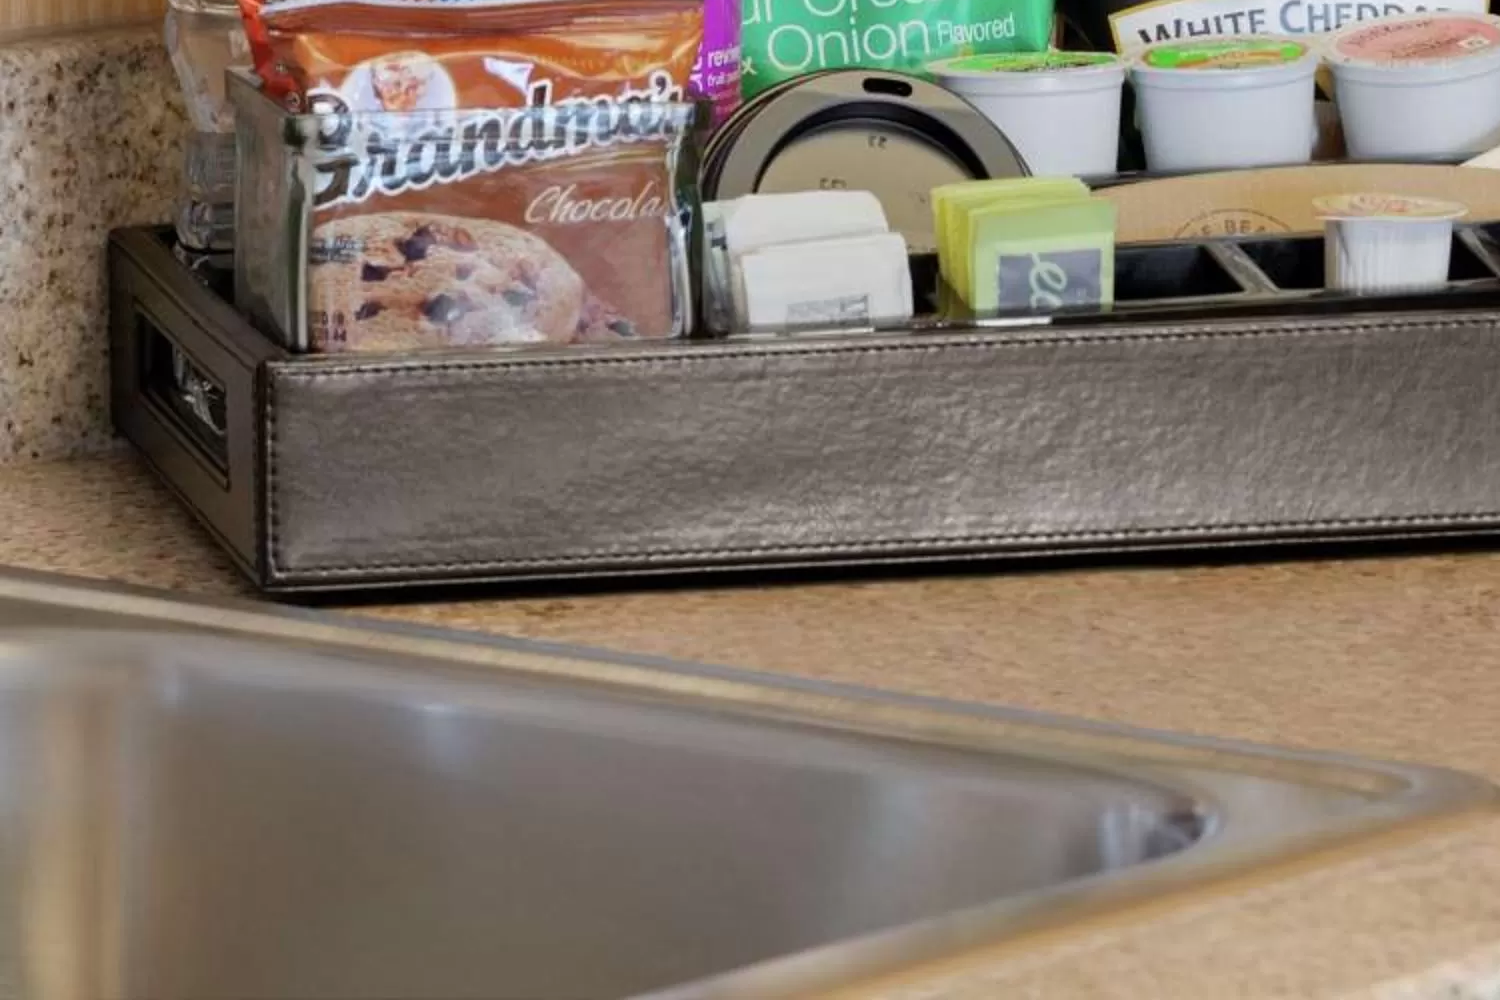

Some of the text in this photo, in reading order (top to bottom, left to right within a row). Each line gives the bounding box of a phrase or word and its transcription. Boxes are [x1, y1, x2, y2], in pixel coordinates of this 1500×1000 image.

[767, 17, 931, 73] Onion
[937, 11, 1016, 48] Flavored
[1137, 7, 1266, 43] WHITE
